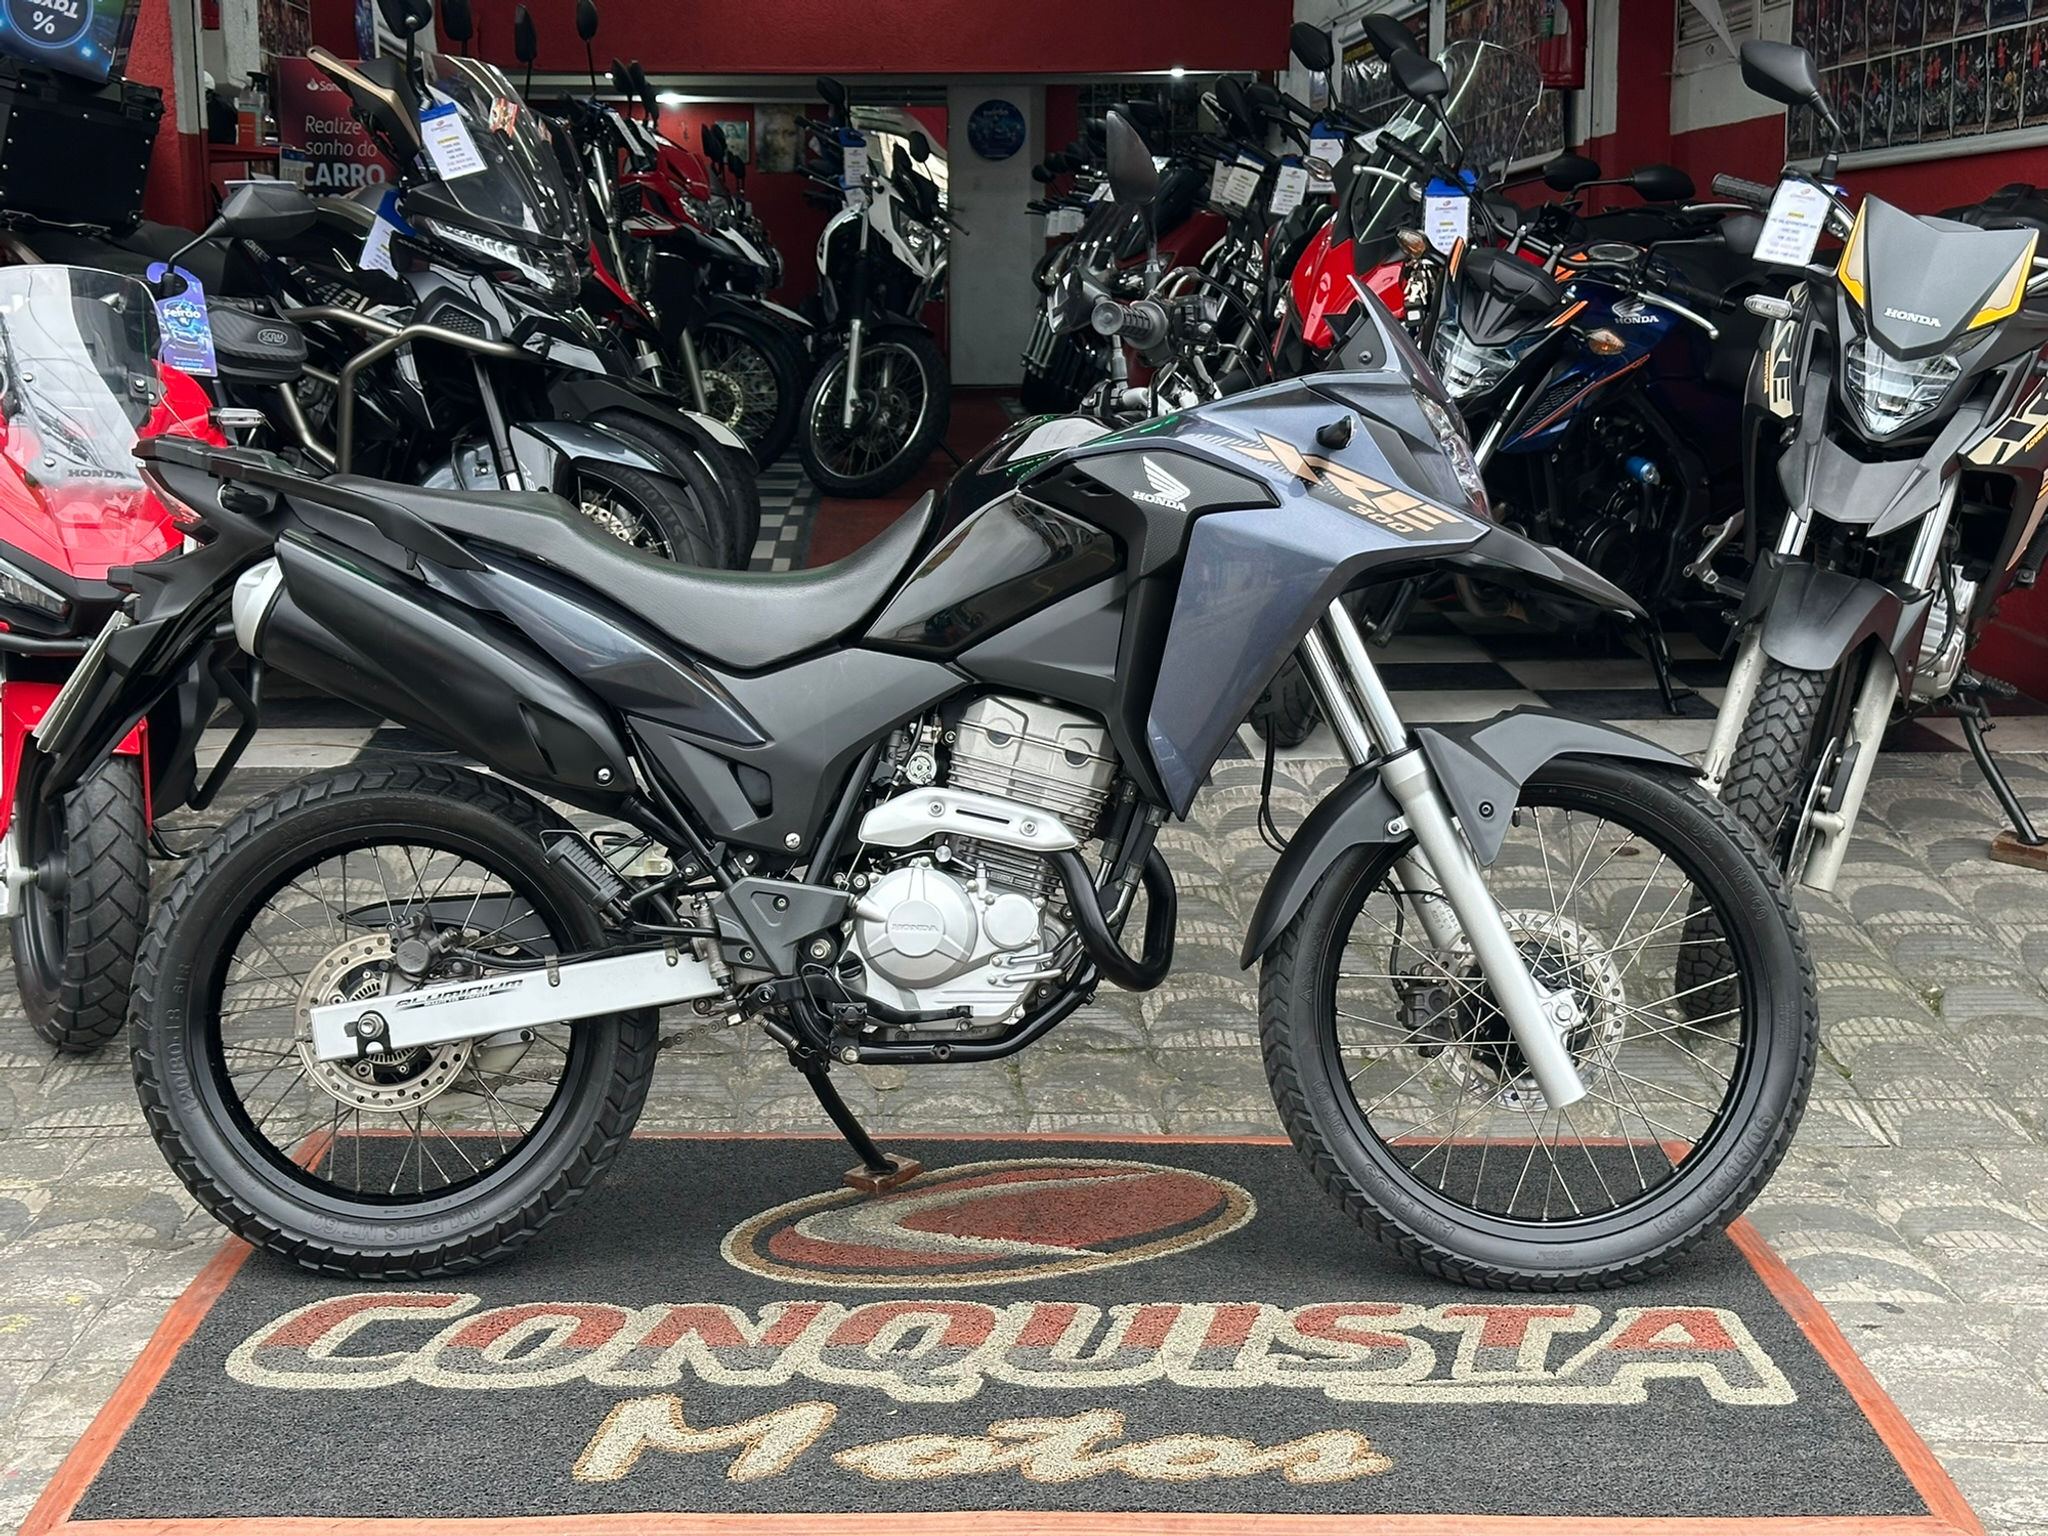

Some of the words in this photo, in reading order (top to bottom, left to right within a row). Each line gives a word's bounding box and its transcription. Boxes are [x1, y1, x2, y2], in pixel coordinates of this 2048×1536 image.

[28, 0, 78, 18] Tax
[305, 115, 361, 135] Realize
[305, 139, 353, 156] sonho
[357, 140, 377, 157] do
[303, 162, 385, 187] CARRO
[1614, 315, 1660, 325] HONDA
[1884, 307, 1941, 328] HONDA
[68, 469, 127, 479] HONDA
[1228, 432, 1464, 532] XRE
[1132, 490, 1187, 512] HONDA
[1348, 503, 1414, 533] 300
[891, 922, 940, 932] HONDA
[384, 1219, 446, 1242] PLUS
[226, 1291, 1797, 1406] CONQUISTA
[572, 1393, 1393, 1484] Motos
